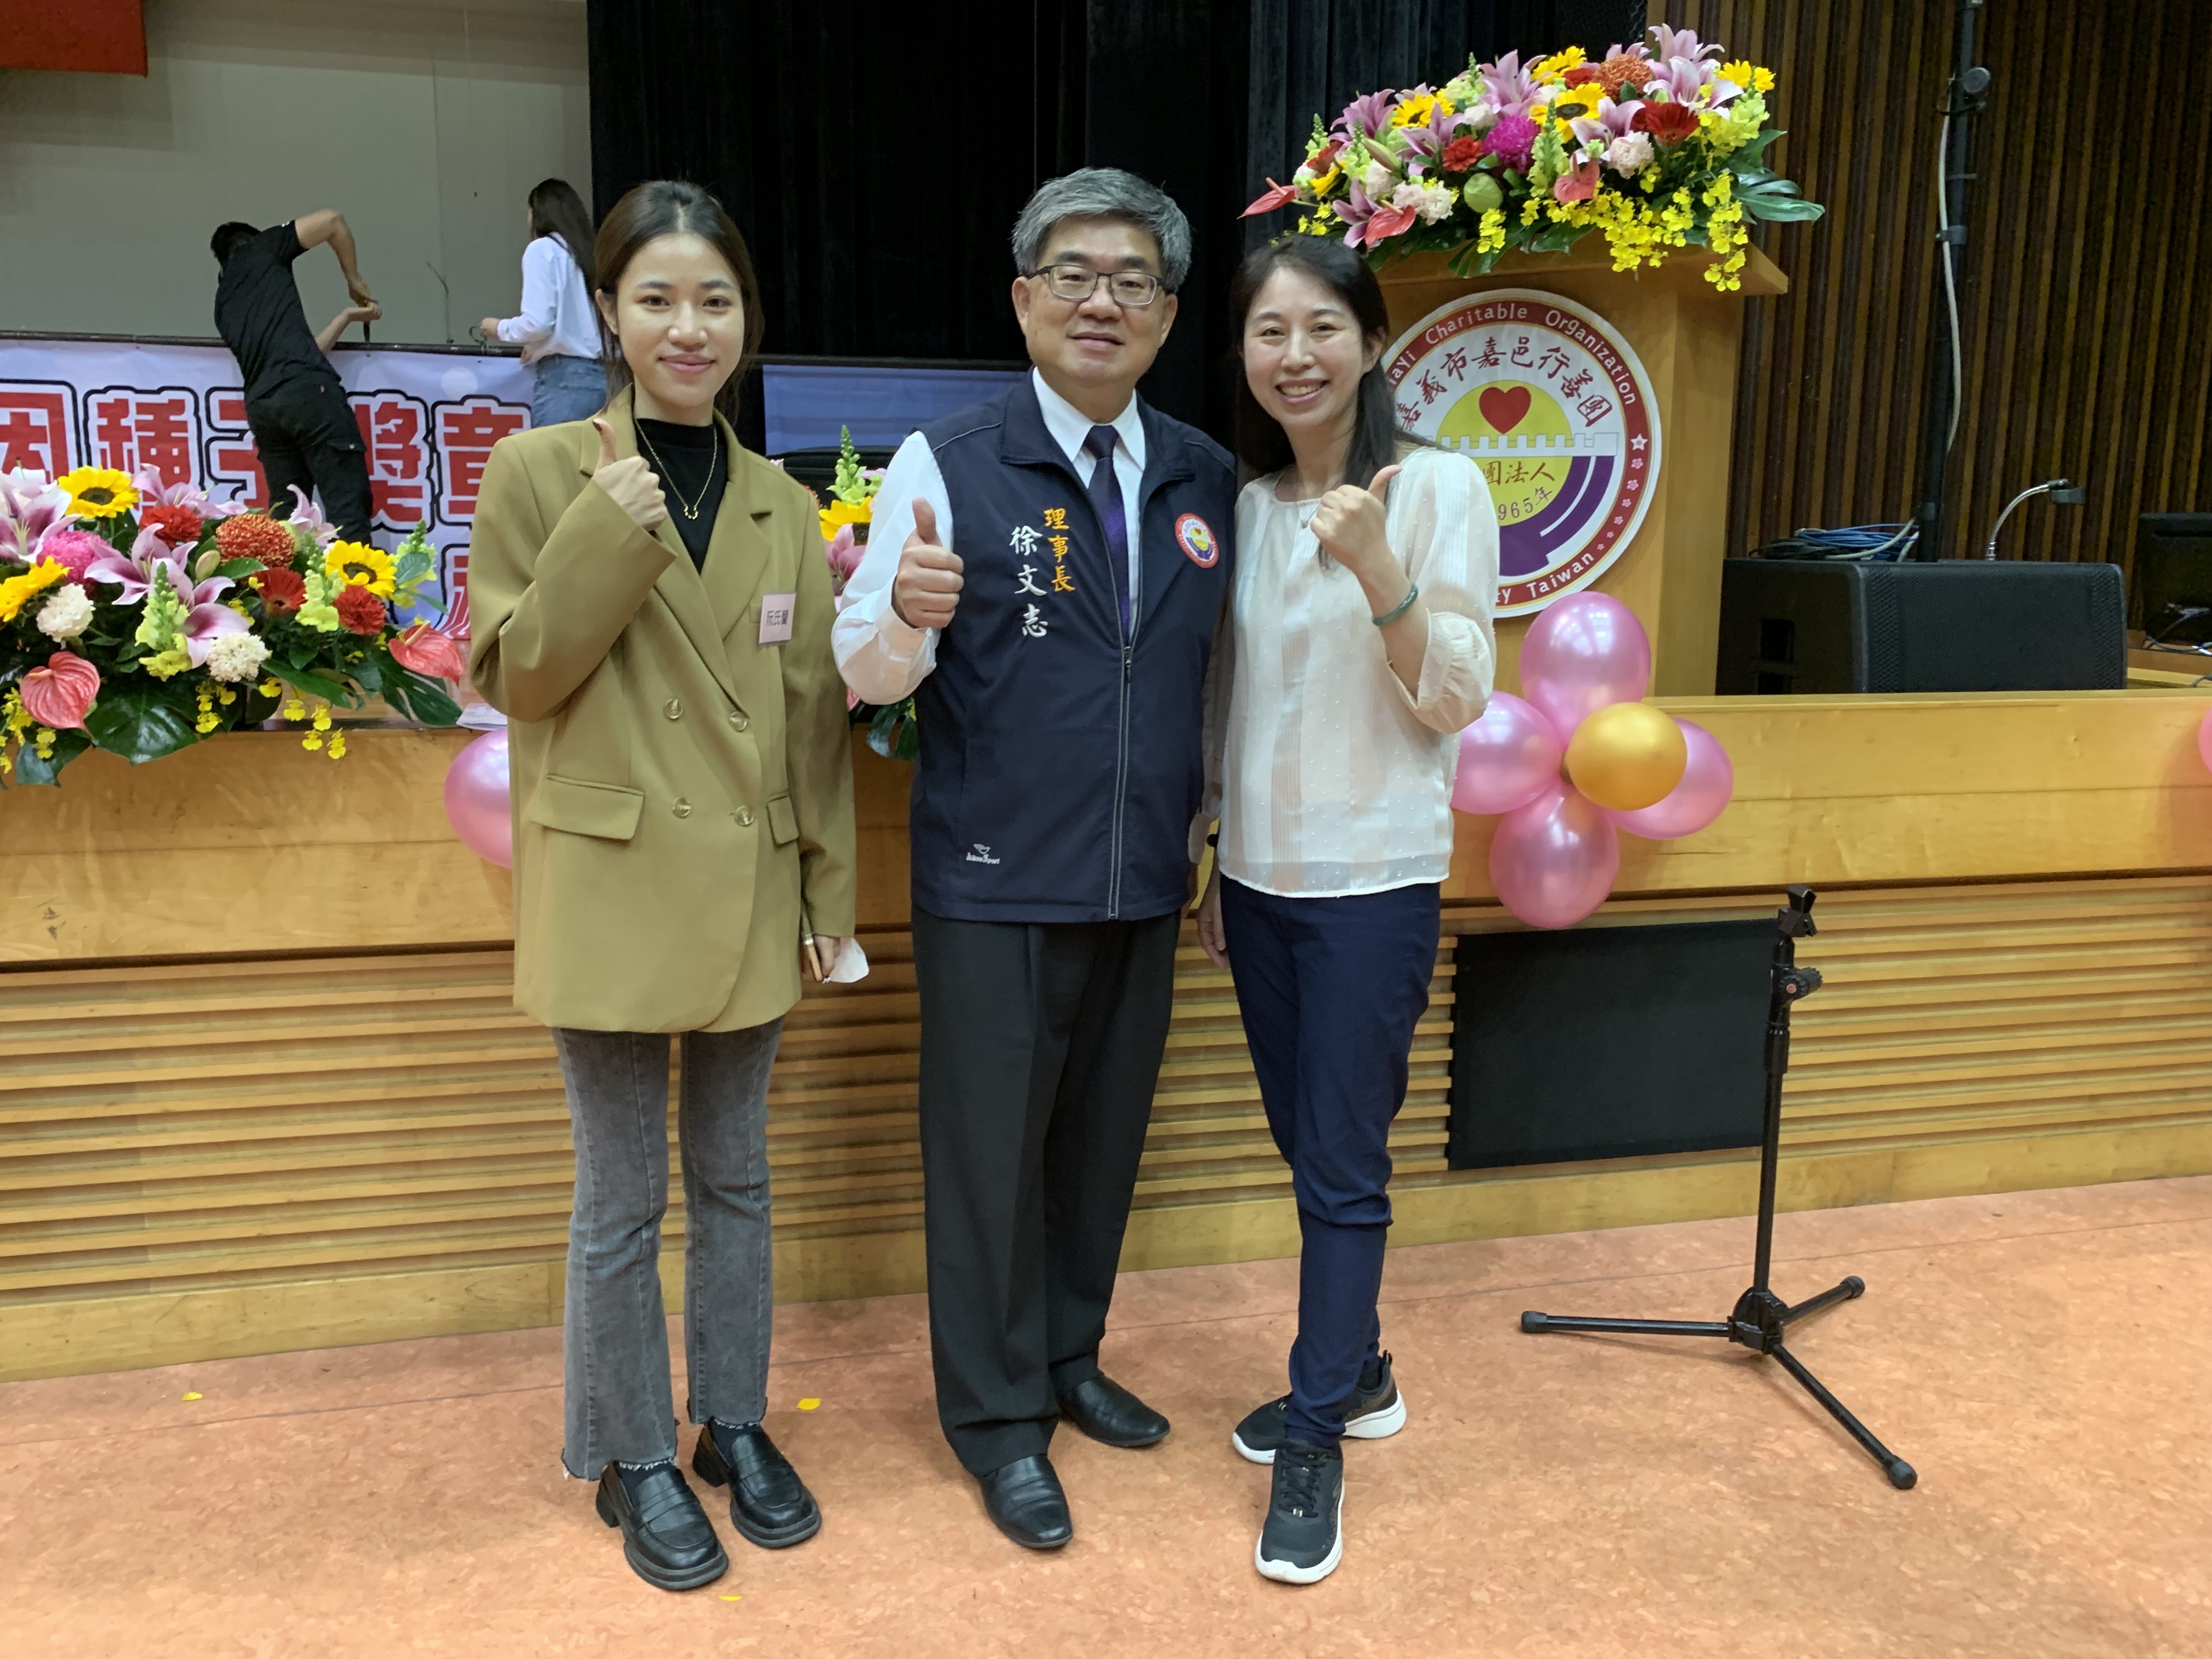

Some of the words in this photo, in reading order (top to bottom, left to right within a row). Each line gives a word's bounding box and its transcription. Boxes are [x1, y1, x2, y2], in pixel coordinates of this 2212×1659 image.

[1396, 336, 1612, 431] 嘉義市嘉邑行善團
[1425, 303, 1528, 345] Charitable
[1545, 309, 1636, 405] Organization
[1009, 525, 1048, 638] 徐文志
[1043, 507, 1076, 592] 理事長
[1526, 552, 1595, 599] Taiwan
